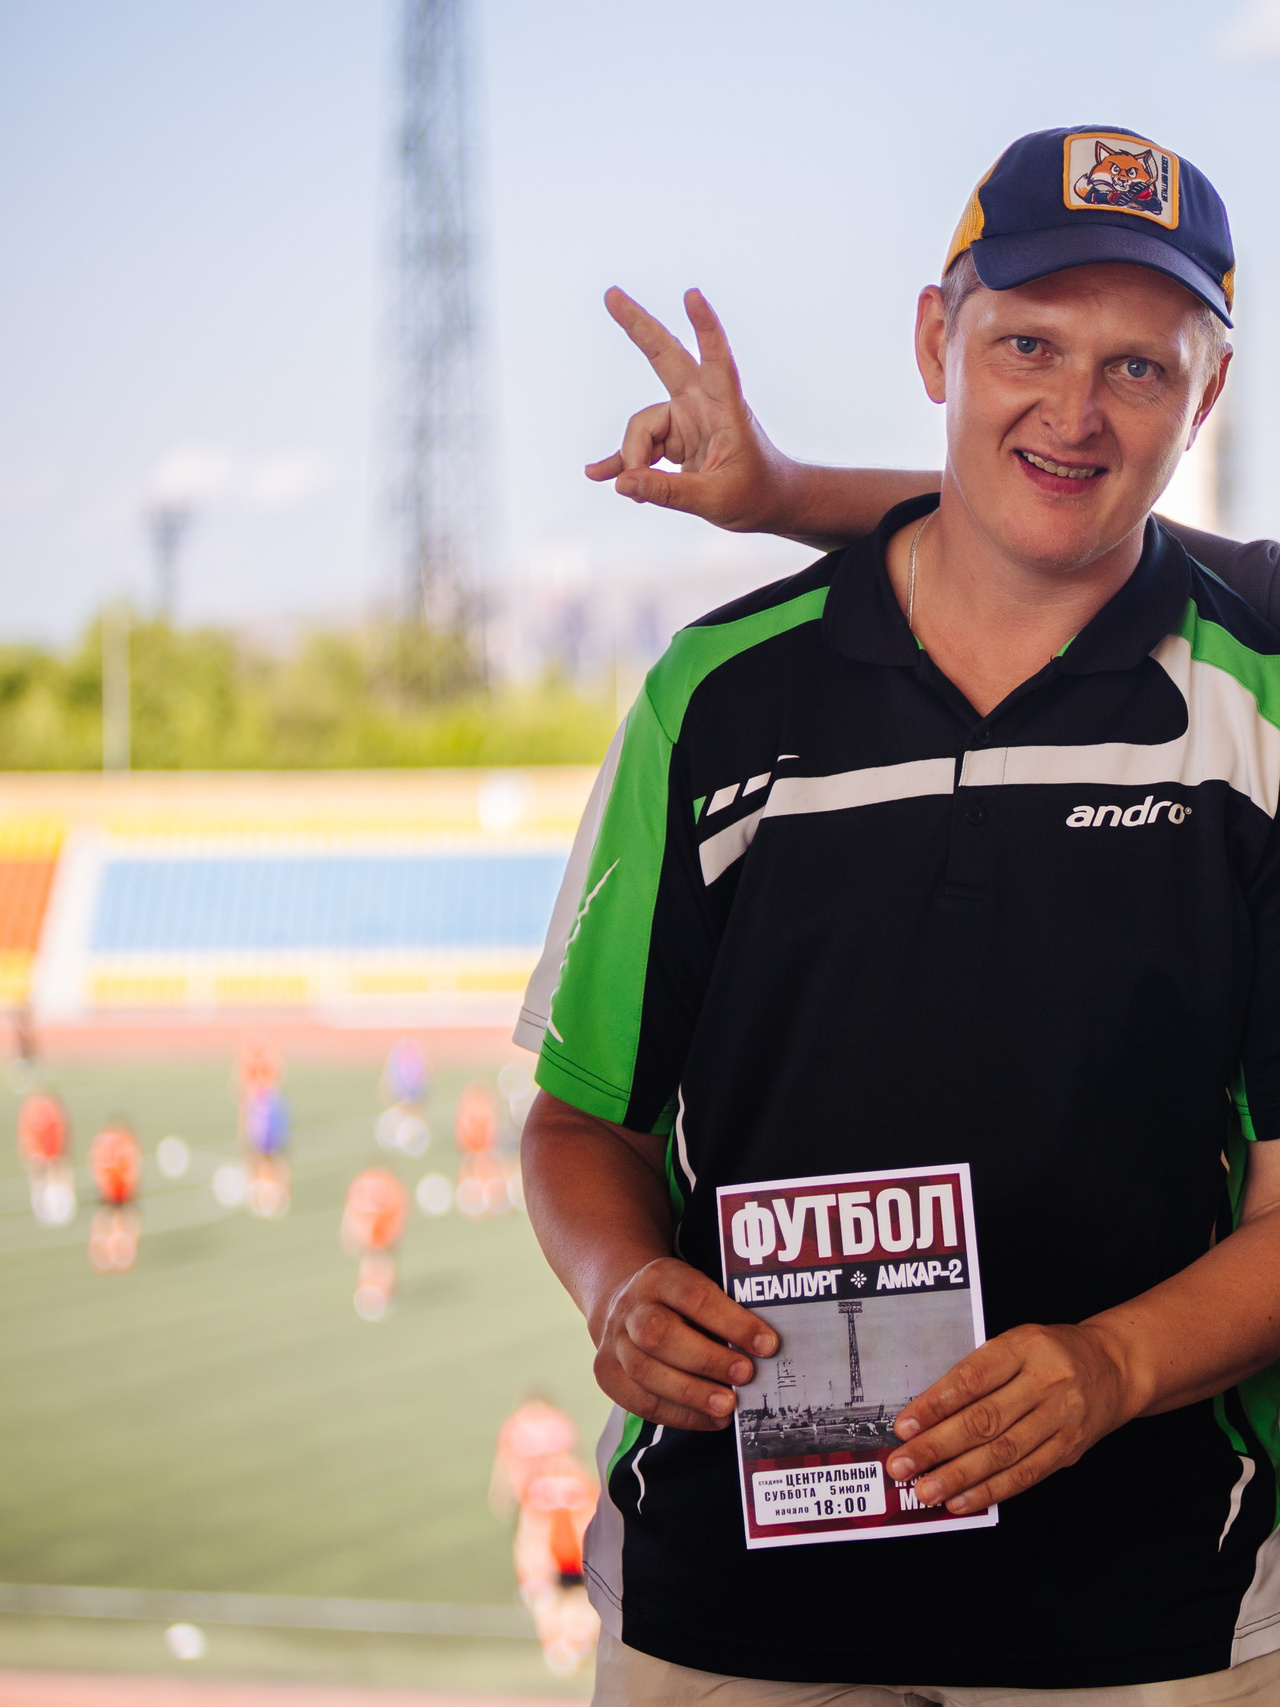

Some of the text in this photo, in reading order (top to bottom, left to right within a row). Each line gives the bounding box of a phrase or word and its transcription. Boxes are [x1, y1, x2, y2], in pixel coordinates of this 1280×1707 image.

[731, 1183, 958, 1266] ФУТБОЛ
[733, 1259, 964, 1303] МЕТАЛЛУРГ АМКАР-2
[785, 1464, 877, 1487] ЦЕНТРАЛЬНЫЙ
[764, 1487, 816, 1502] СУББОТА
[775, 1496, 867, 1516] начало 18:00
